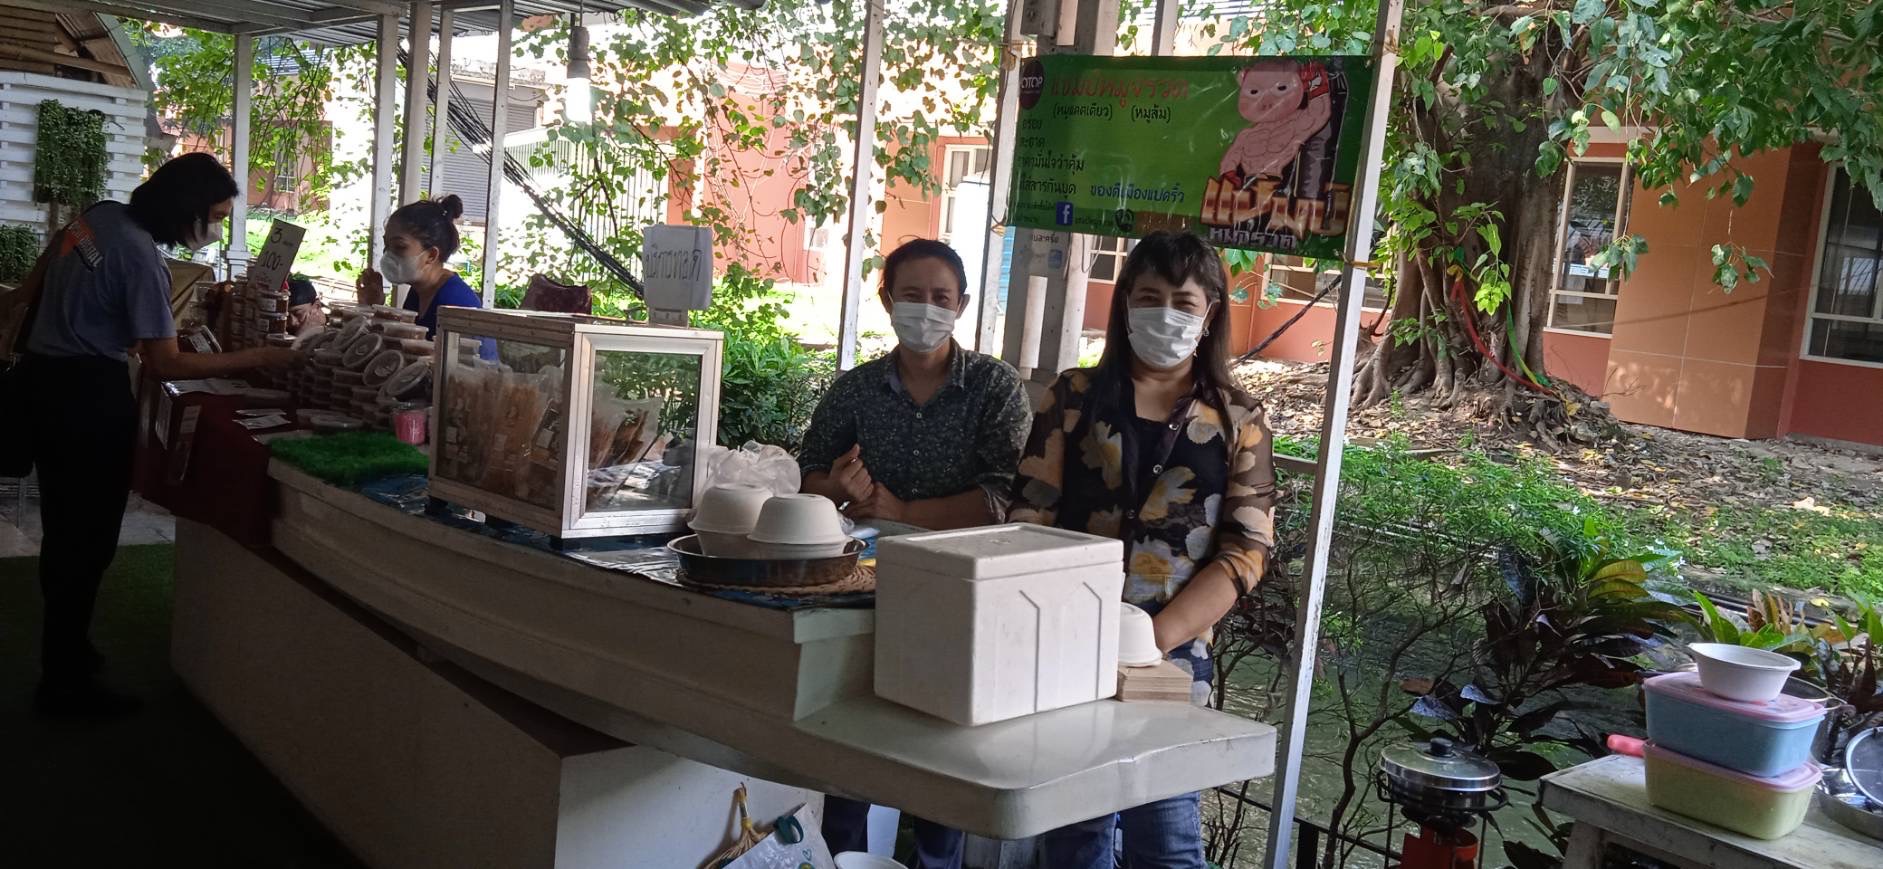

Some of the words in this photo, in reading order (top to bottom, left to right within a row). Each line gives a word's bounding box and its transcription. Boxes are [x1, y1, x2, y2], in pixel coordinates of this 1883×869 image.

[1021, 76, 1044, 89] OTOP
[1131, 102, 1172, 124] (หมูส้ม)
[270, 227, 283, 244] 3
